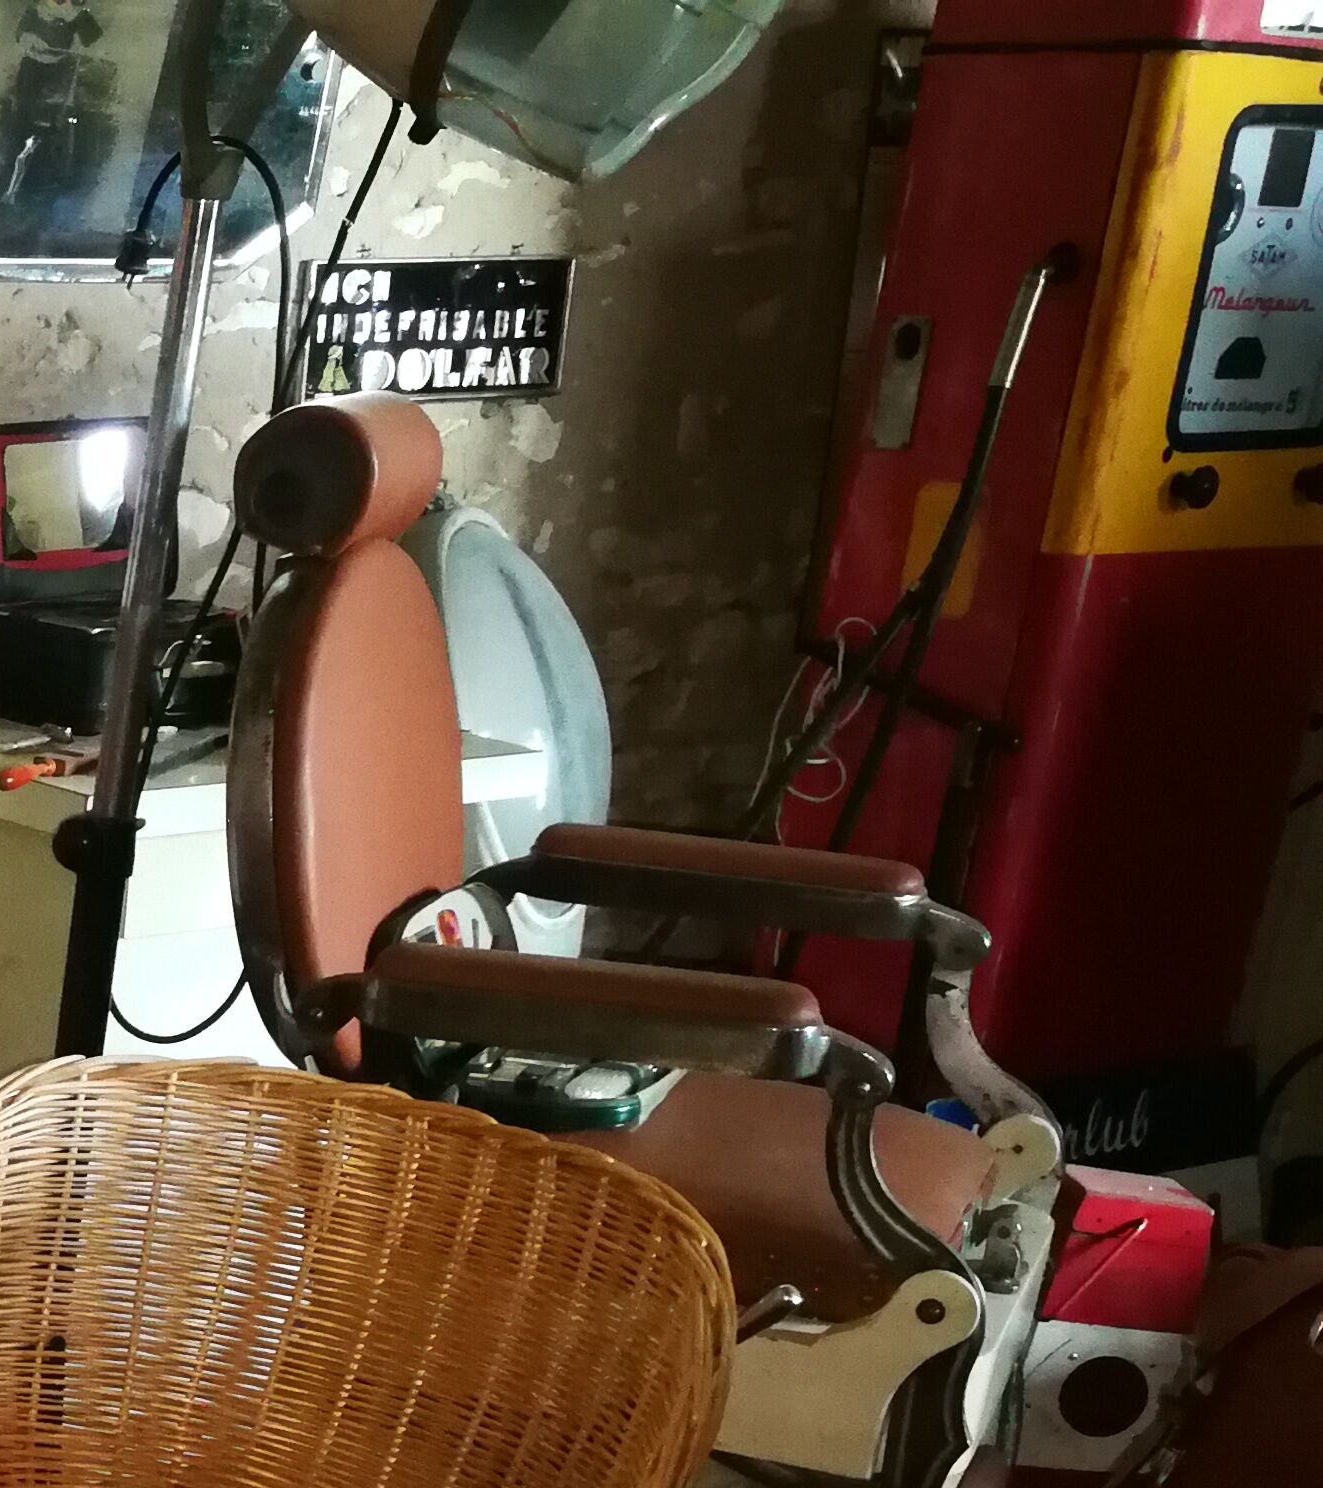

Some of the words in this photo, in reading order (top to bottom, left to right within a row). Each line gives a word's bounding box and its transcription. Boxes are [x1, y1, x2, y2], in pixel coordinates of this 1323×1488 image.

[321, 269, 392, 305] ICI
[316, 306, 550, 345] INDEFRISABLE
[360, 346, 550, 391] DOLFAR
